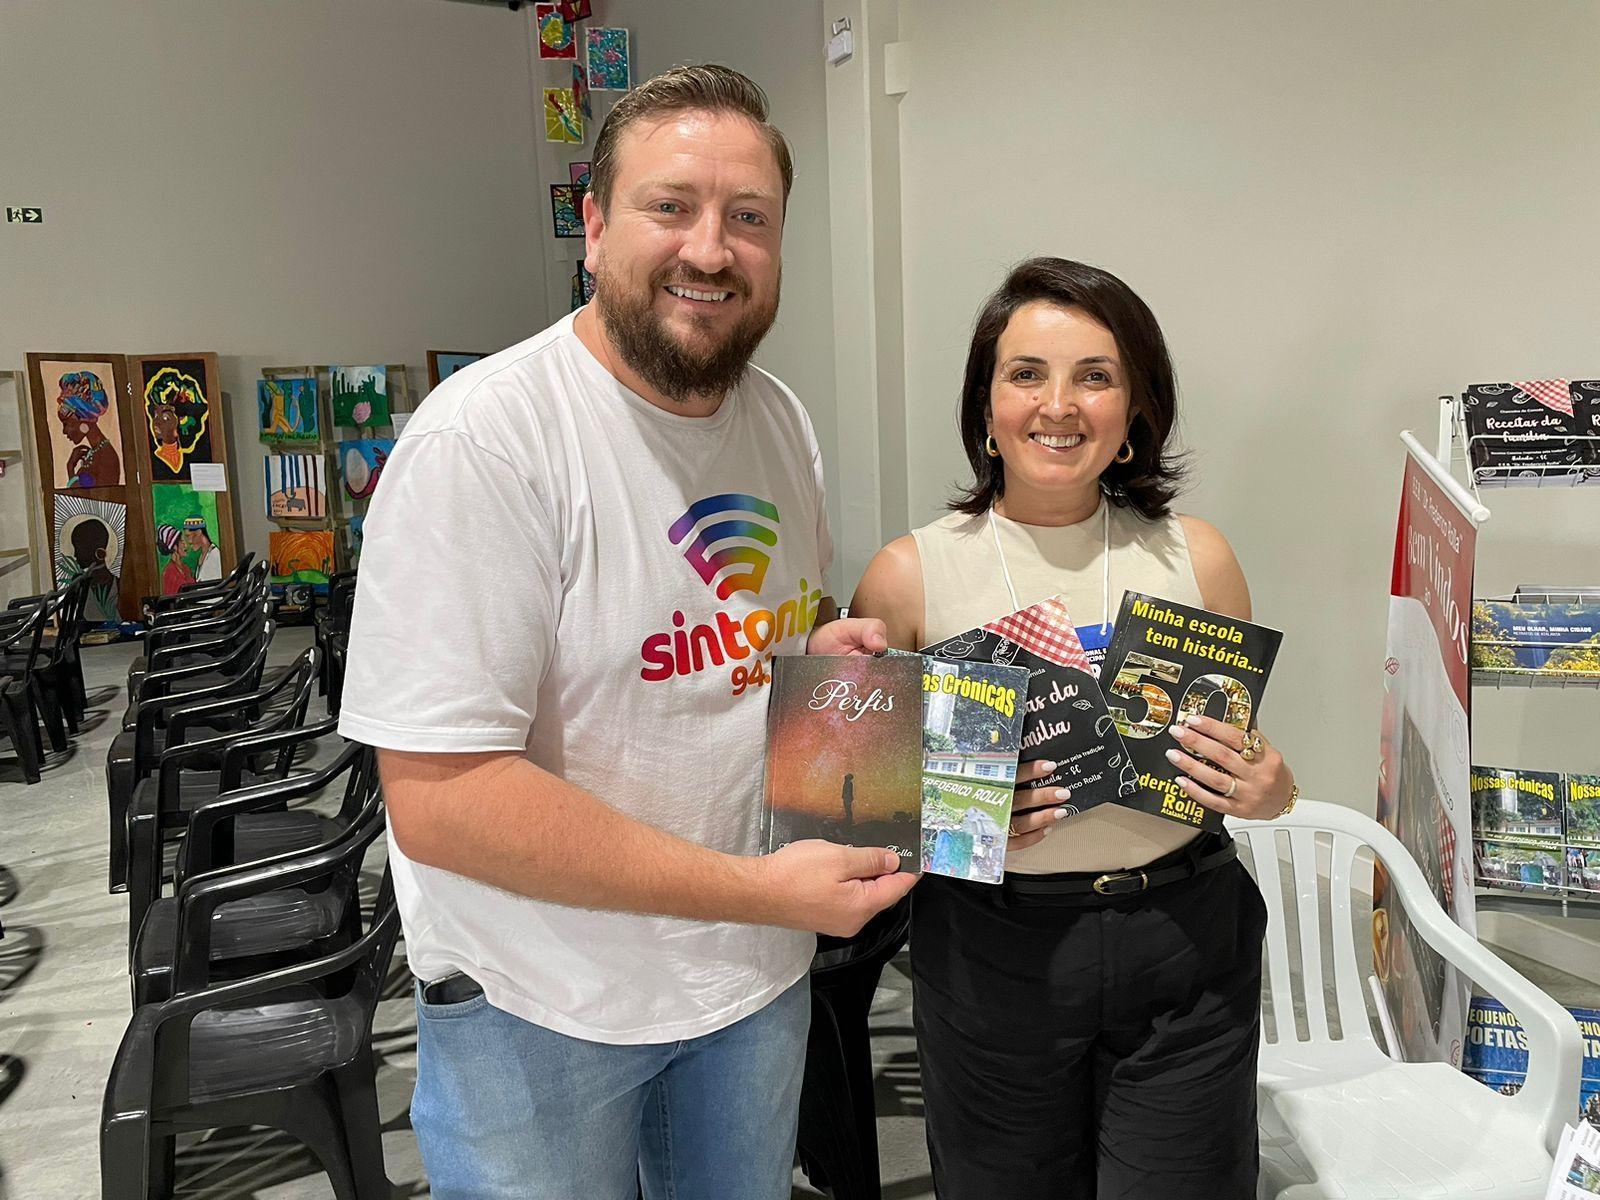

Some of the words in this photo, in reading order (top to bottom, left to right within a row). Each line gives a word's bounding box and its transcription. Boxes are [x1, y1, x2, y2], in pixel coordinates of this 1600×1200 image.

[1486, 416, 1539, 430] Receitas
[1540, 415, 1562, 426] da
[640, 577, 823, 682] sintonia
[1131, 599, 1185, 628] Minha
[1188, 617, 1245, 645] escola
[1145, 627, 1178, 650] tem
[1182, 636, 1264, 674] história...
[730, 651, 772, 696] 94.
[808, 679, 895, 722] Perfis
[942, 674, 1016, 718] Crônicas
[1023, 695, 1047, 715] as
[1050, 680, 1079, 705] da
[972, 787, 1010, 807] ROLLA
[1163, 793, 1205, 819] Rolla
[1471, 774, 1505, 792] Nossas
[1508, 776, 1555, 801] Crônicas
[1468, 1008, 1521, 1028] EQUENO
